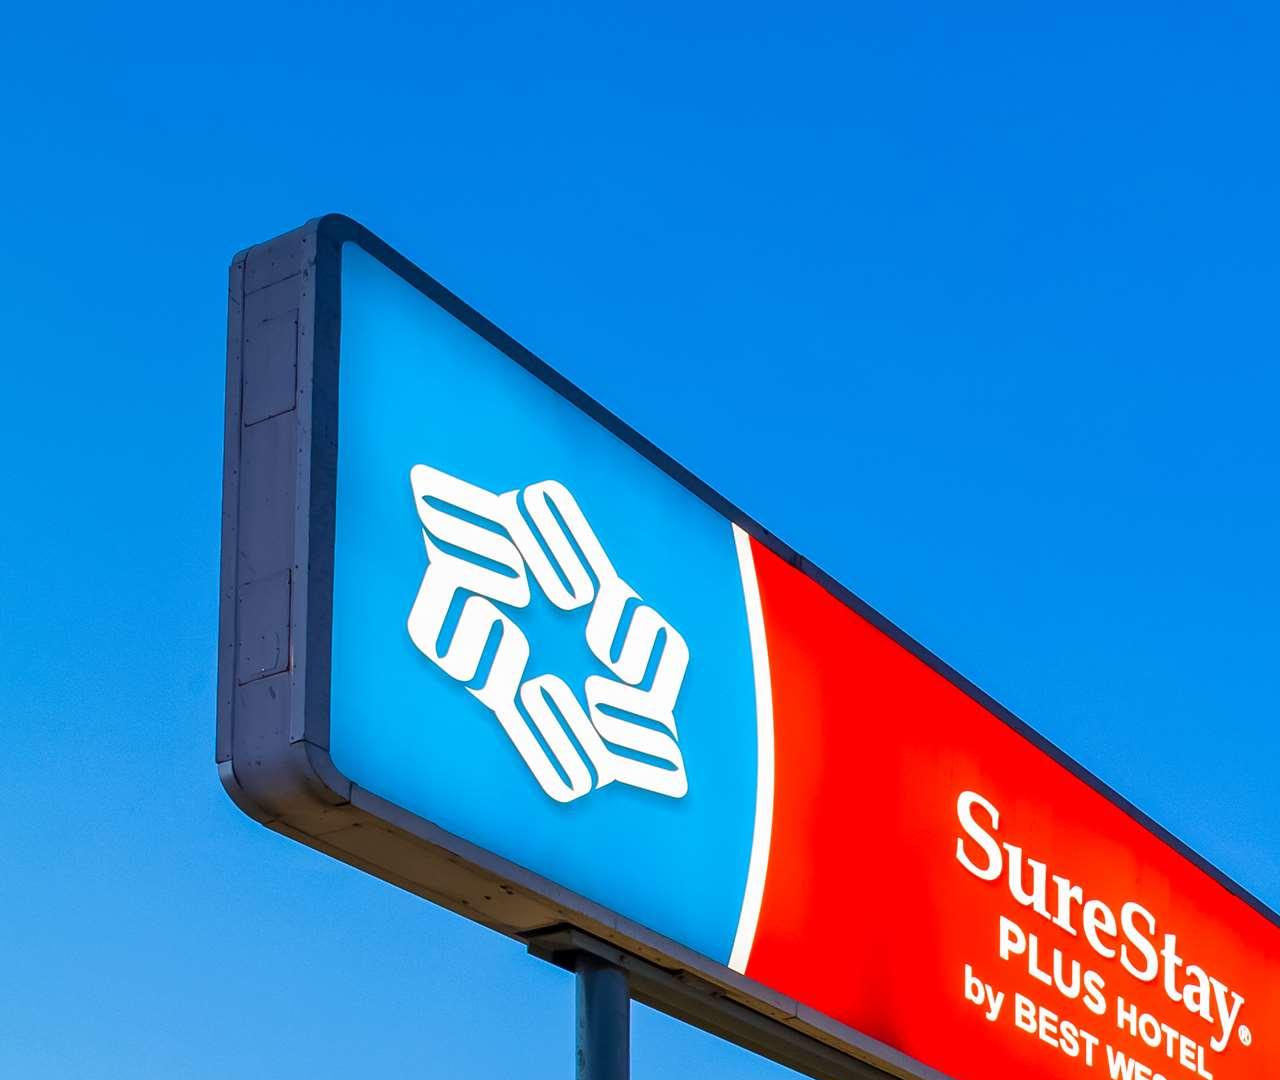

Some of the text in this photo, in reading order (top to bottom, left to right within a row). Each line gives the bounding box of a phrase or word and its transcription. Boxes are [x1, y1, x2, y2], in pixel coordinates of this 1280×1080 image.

[964, 963, 1005, 1022] by
[1014, 992, 1100, 1067] BEST
[999, 915, 1107, 1015] PLUS
